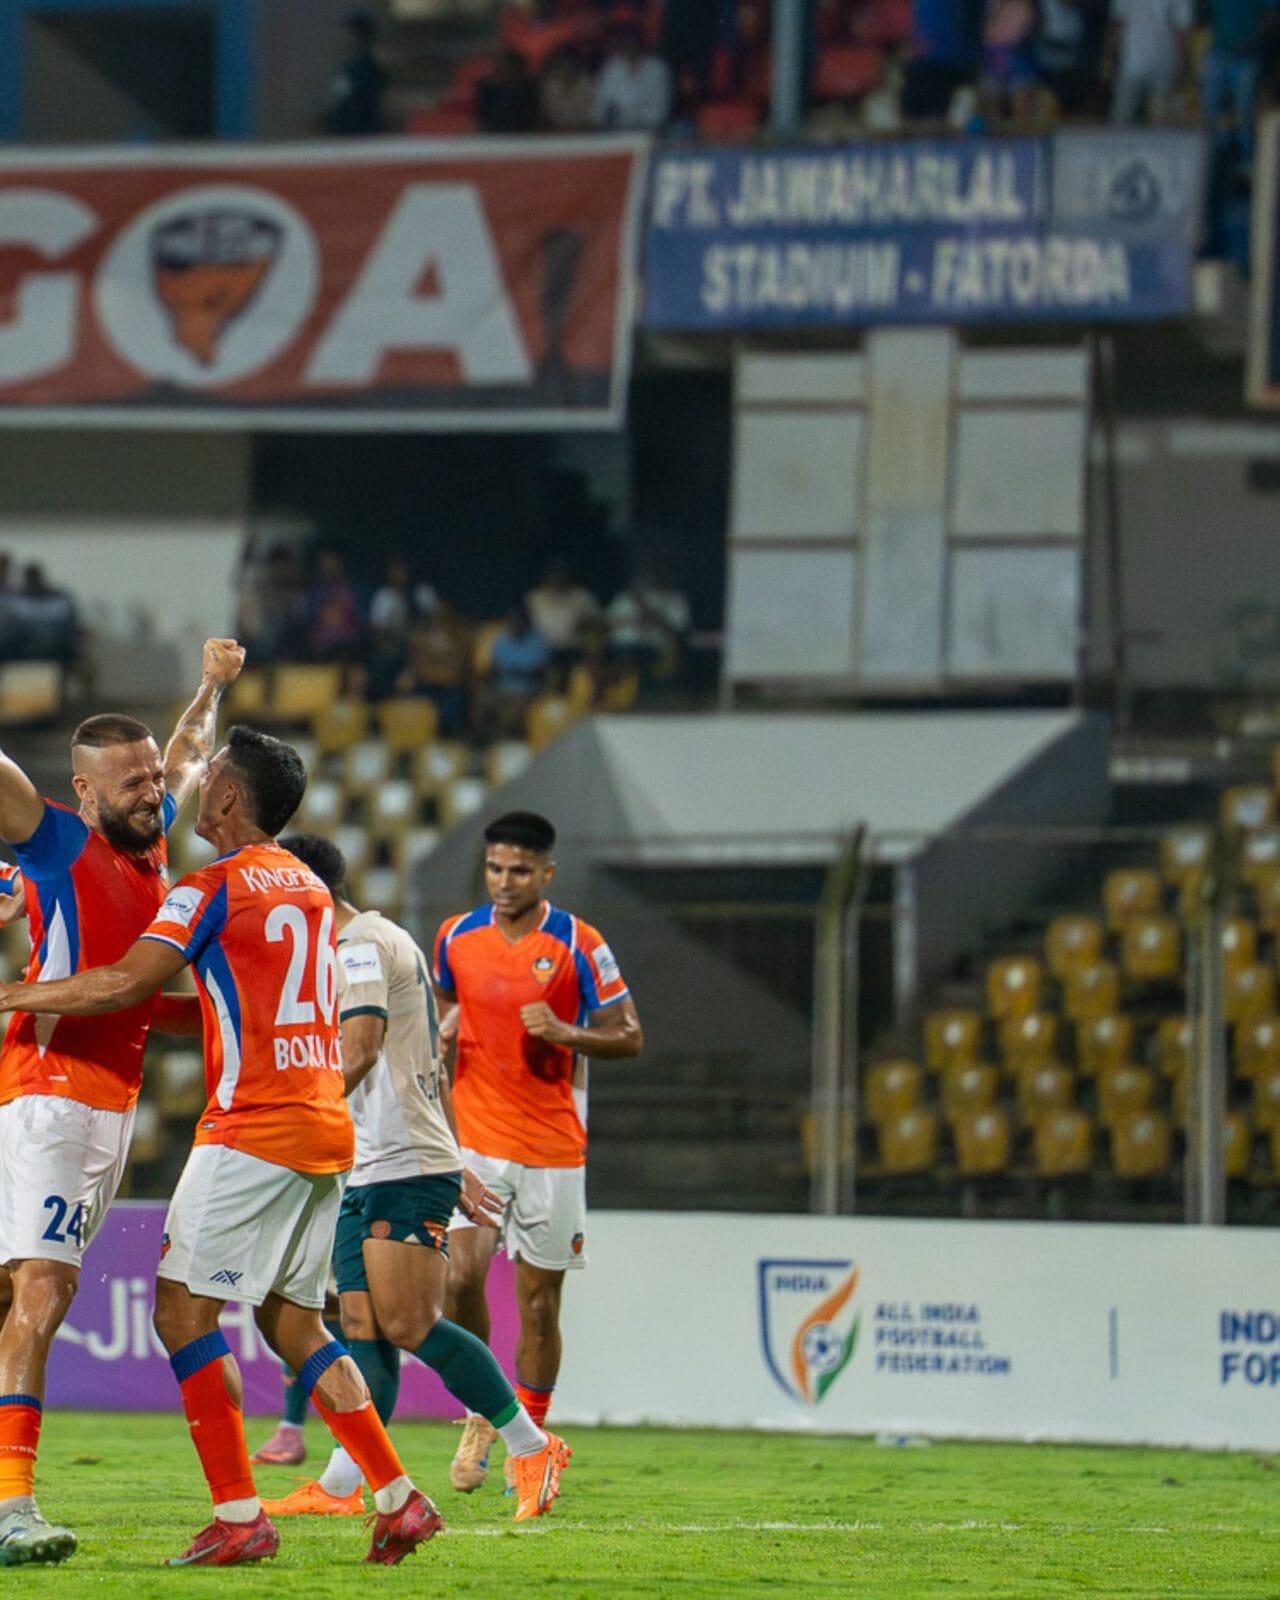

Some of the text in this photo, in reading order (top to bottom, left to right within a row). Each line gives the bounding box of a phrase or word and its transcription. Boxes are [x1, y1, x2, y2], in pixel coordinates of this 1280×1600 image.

[702, 243, 899, 312] STADIUM
[932, 238, 1129, 306] FATORDA
[264, 904, 338, 1026] 26
[42, 1194, 84, 1247] 24
[774, 1274, 831, 1293] INDIA
[874, 1303, 980, 1323] ALL INDIA
[1220, 1310, 1280, 1344] IND
[875, 1327, 985, 1349] FOOTBALL
[876, 1352, 1012, 1374] FEDERATION
